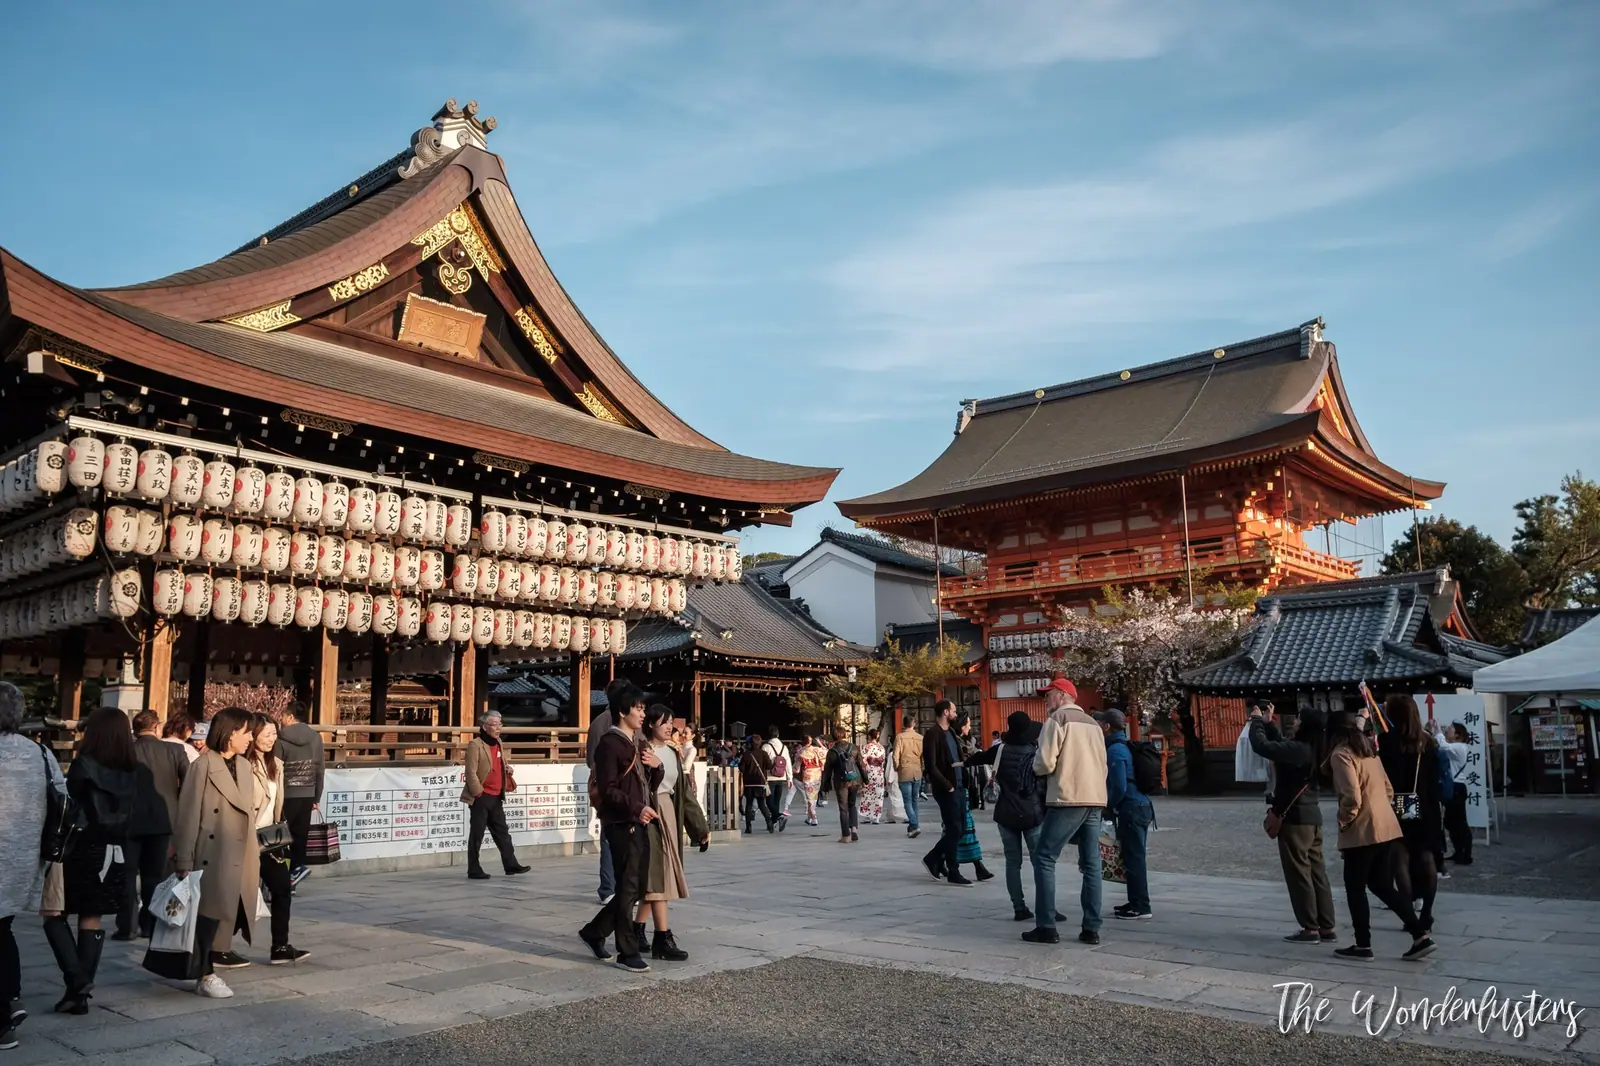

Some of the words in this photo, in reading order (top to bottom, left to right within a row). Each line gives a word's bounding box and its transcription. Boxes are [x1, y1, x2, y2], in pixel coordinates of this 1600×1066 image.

[117, 446, 133, 488] 家田荘子
[151, 453, 167, 491] 貴久政
[216, 465, 232, 500] たまや
[278, 476, 291, 512] 富美代
[306, 480, 320, 516] いし初
[334, 486, 346, 521] 堀八重
[362, 491, 374, 523] 利きみ
[517, 517, 526, 549] まつもと
[356, 553, 368, 574] 松本
[509, 565, 519, 591] 小花
[601, 619, 610, 649] カトレヤ
[1464, 711, 1482, 807] 御朱印受付
[421, 775, 457, 786] 平成31年
[331, 806, 349, 814] 25歳
[358, 804, 388, 813] 平成8年生
[397, 803, 424, 811] 平成7年生
[560, 795, 585, 803] 平成12年生
[355, 818, 390, 827] 昭和54年生
[394, 816, 425, 824] 昭和53年生
[528, 809, 556, 817] 昭和62年生
[355, 832, 389, 840] 昭和35年生
[394, 829, 425, 838] 昭和34年生
